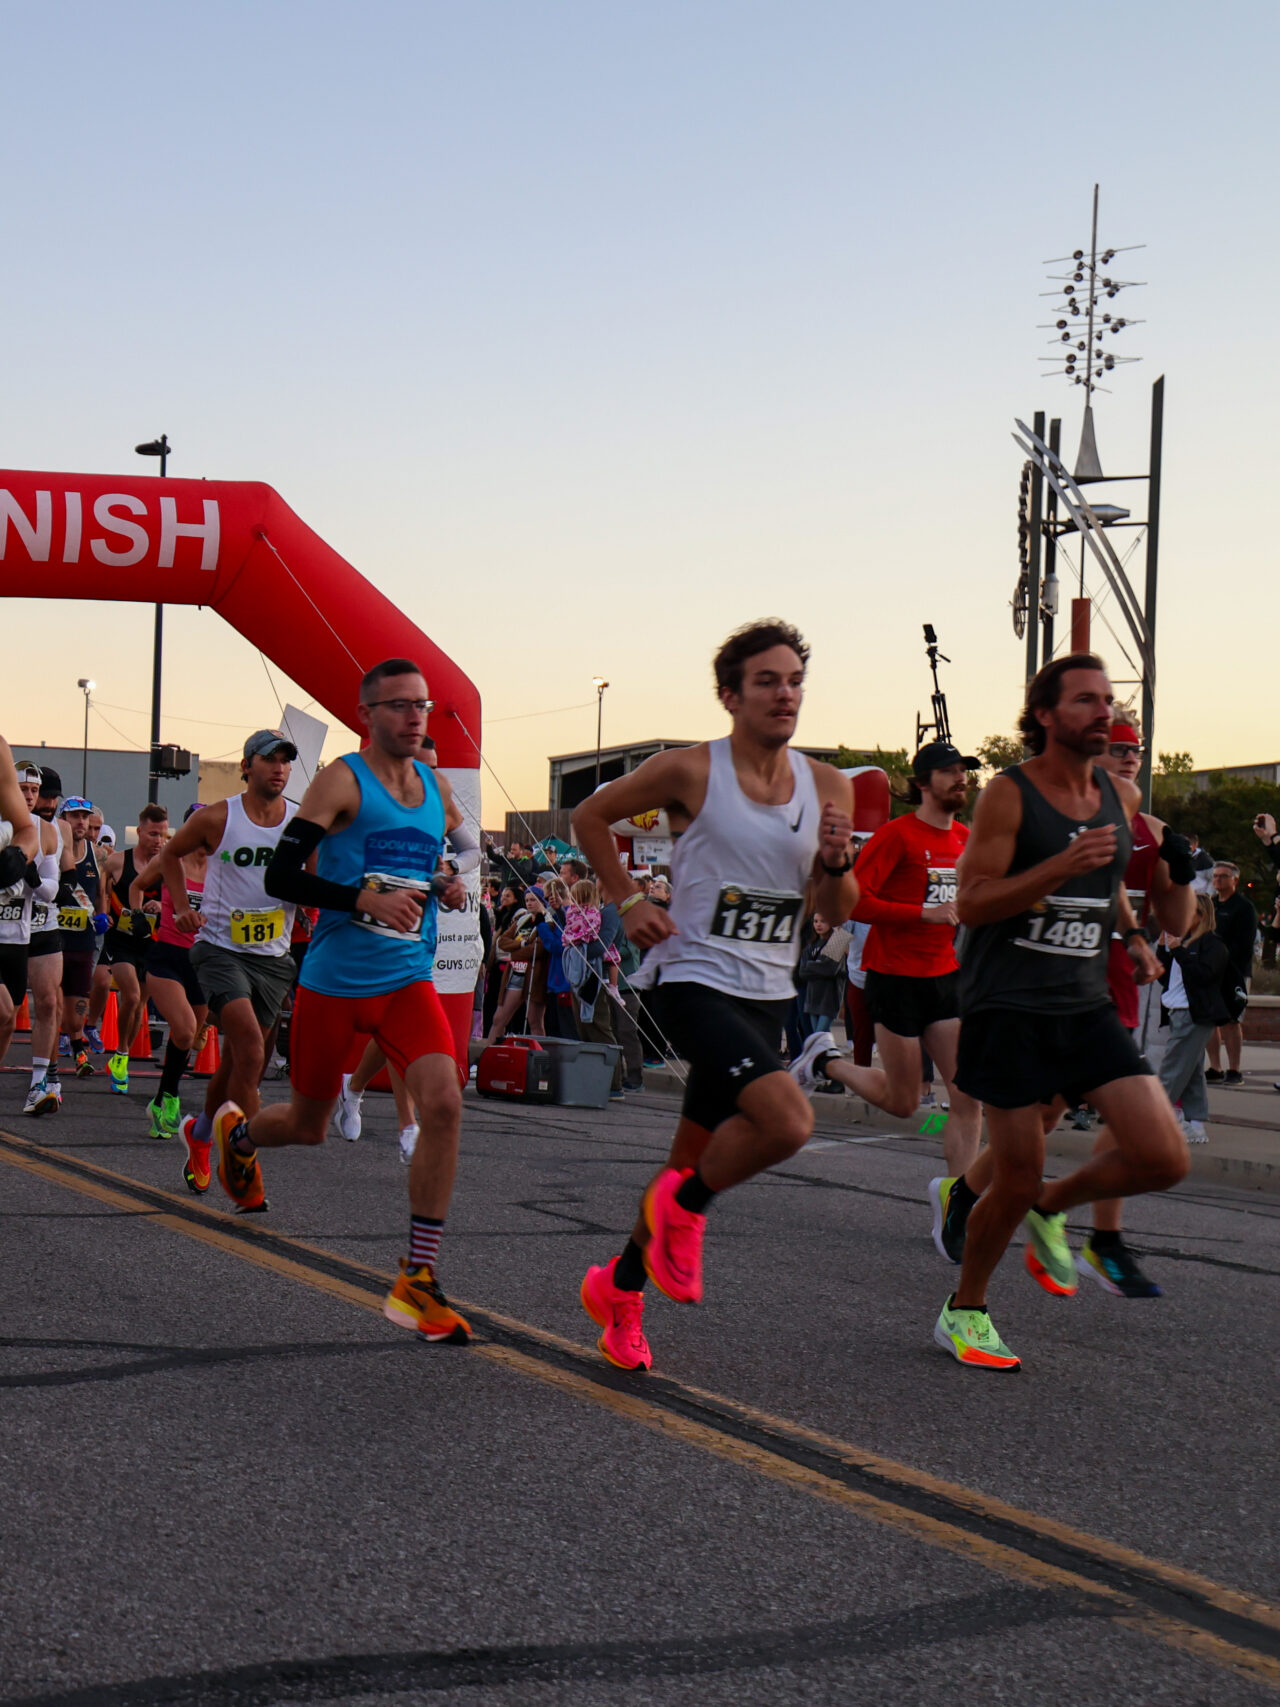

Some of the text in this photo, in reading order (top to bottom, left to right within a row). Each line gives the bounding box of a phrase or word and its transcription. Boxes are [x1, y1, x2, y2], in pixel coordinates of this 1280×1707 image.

[233, 846, 274, 867] OR
[57, 914, 81, 928] 244
[720, 908, 793, 942] 1314
[241, 922, 274, 943] 181
[438, 932, 456, 944] just
[457, 934, 463, 942] a
[1027, 917, 1102, 949] 1489
